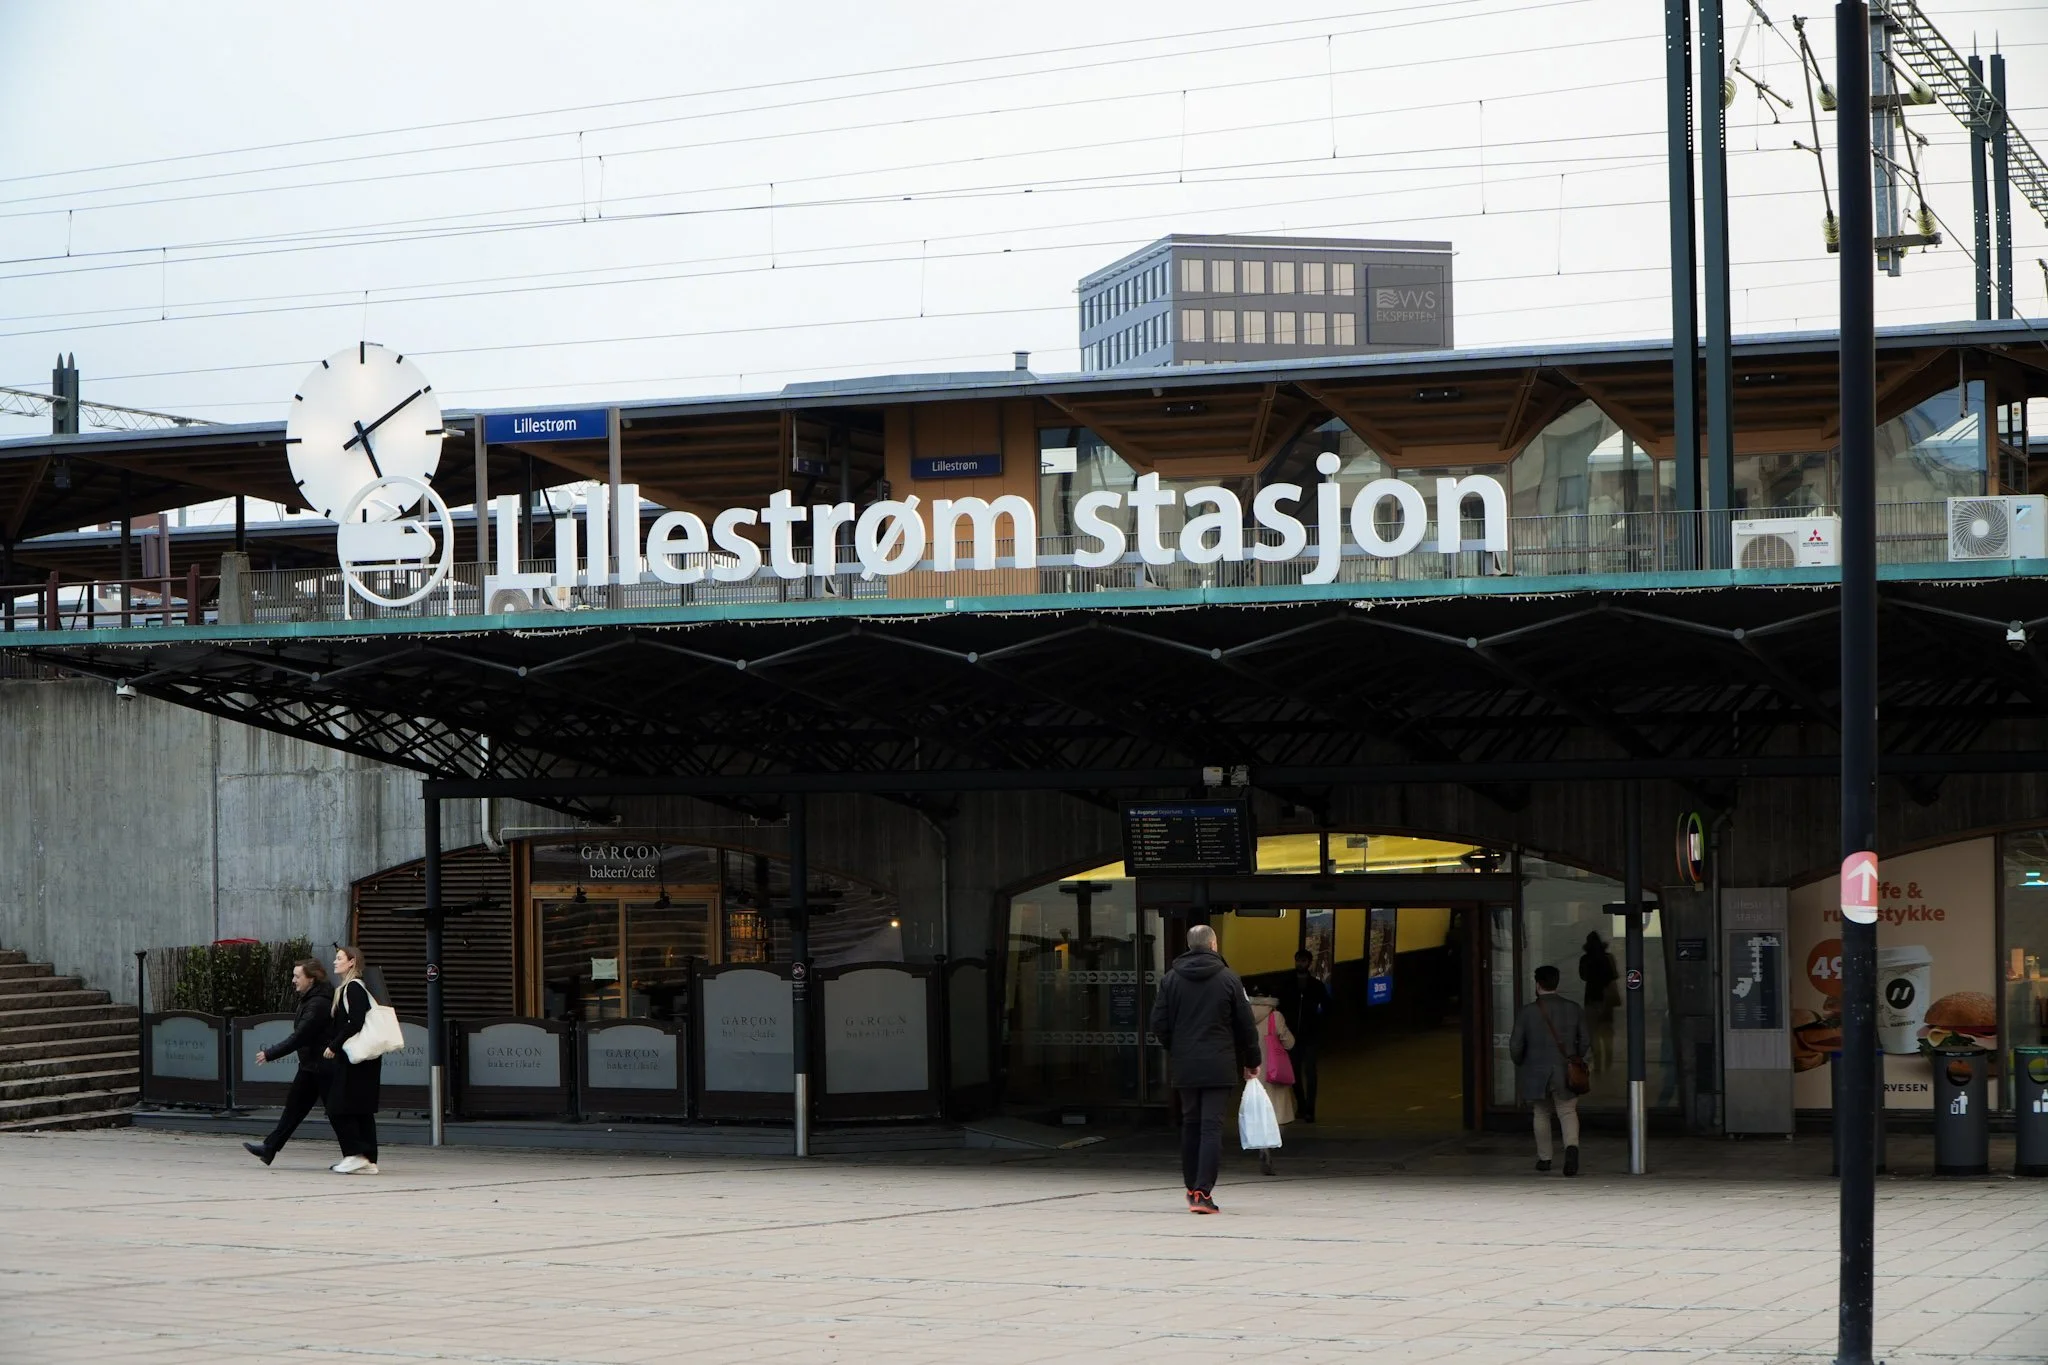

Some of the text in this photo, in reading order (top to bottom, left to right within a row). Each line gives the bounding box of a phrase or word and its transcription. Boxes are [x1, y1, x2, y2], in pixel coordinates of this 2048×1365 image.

[513, 416, 577, 434] Lillestrøm
[931, 459, 978, 473] Lillestrøm
[496, 452, 1508, 589] Lillestrøm stasjon
[581, 846, 663, 862] GARÇON
[590, 864, 656, 878] bakeri/café
[1907, 881, 1924, 899] &
[1823, 904, 1945, 926] rustykke
[721, 1016, 777, 1028] GARÇON
[487, 1047, 544, 1058] GARÇON
[606, 1049, 660, 1060] GARÇON
[1884, 1083, 1929, 1092] RVESEN
